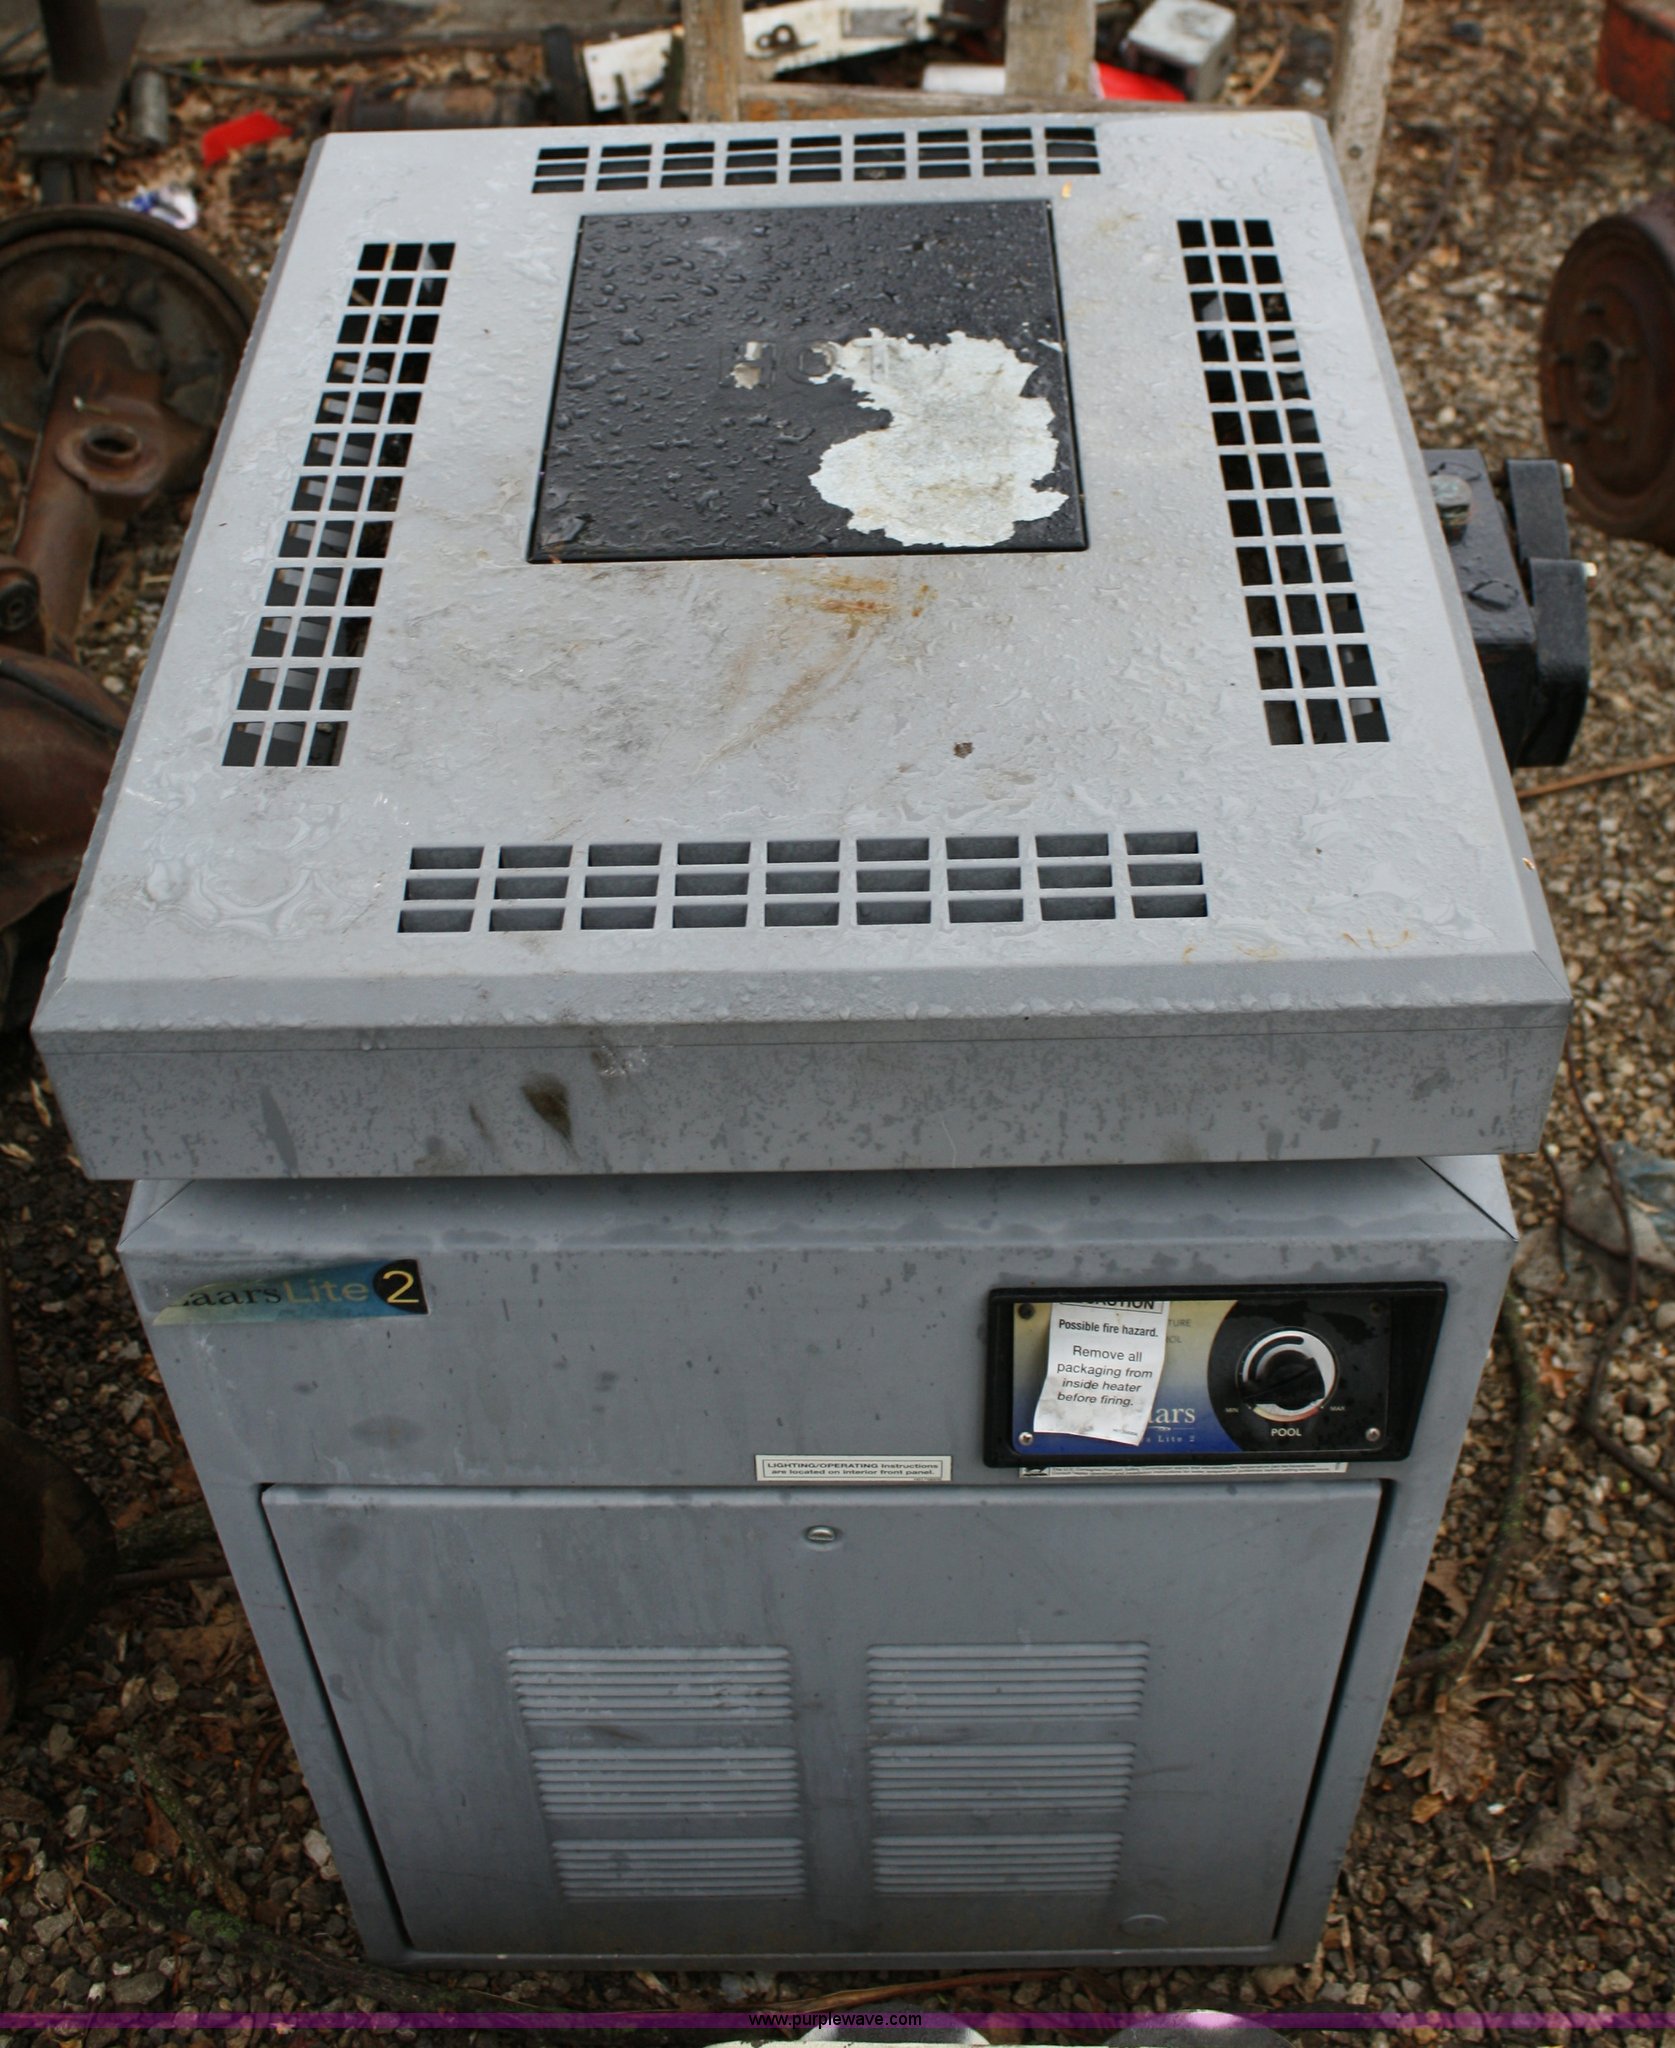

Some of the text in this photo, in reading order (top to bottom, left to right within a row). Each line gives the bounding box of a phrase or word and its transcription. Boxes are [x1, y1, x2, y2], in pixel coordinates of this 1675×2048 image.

[382, 1270, 420, 1304] 2
[1058, 1318, 1160, 1338] Possible fire hazard.
[1072, 1345, 1143, 1362] Remove all
[1056, 1363, 1153, 1379] packaging from
[1061, 1378, 1142, 1393] inside heater
[1056, 1391, 1134, 1408] before firing.
[1270, 1427, 1302, 1437] POOL
